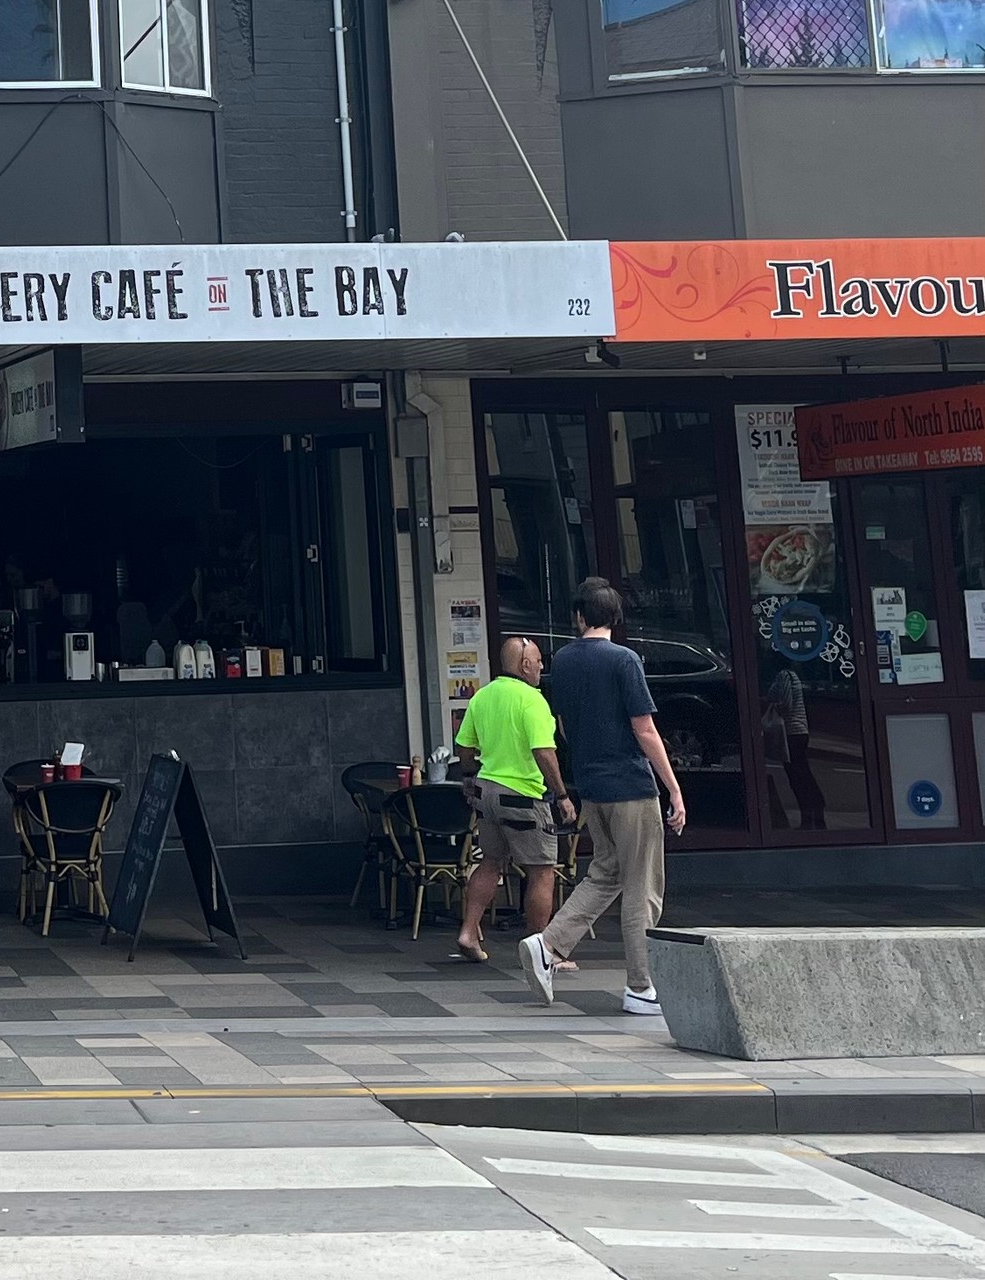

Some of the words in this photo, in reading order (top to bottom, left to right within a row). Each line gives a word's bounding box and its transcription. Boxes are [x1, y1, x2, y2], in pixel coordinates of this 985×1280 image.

[91, 261, 188, 321] CAFÉ
[208, 284, 227, 303] ON
[245, 268, 319, 318] THE
[334, 266, 409, 316] BAY
[568, 298, 591, 316] 232
[831, 414, 879, 445] Flavour
[884, 408, 897, 440] of
[901, 403, 943, 438] North
[945, 399, 985, 434] India
[835, 457, 854, 471] DINE
[854, 457, 863, 470] IN
[864, 456, 875, 469] OR
[876, 452, 918, 468] TAKEAWAY
[925, 451, 939, 465] Tel:
[962, 446, 983, 462] 2595
